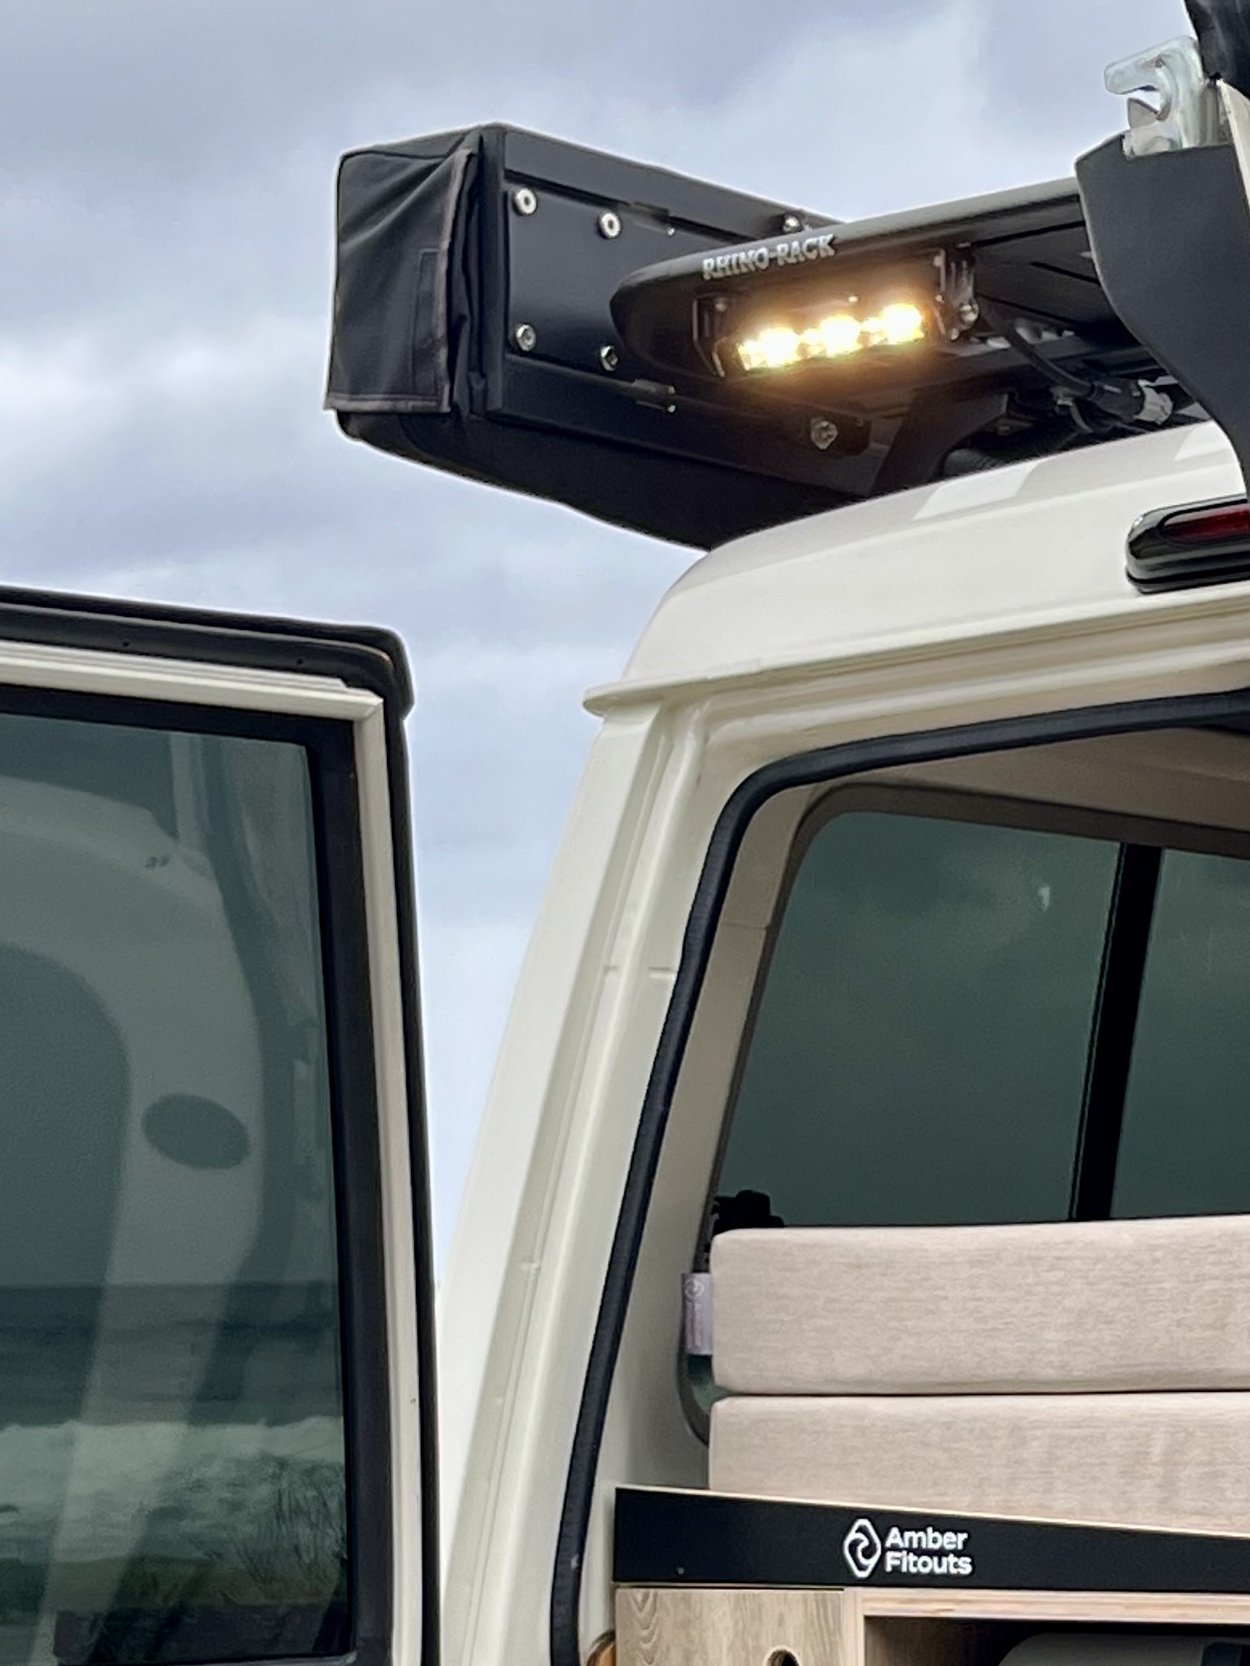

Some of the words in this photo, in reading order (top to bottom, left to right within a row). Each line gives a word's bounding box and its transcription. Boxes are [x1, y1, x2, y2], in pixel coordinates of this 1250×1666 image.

[702, 233, 836, 280] RHINO-RACK
[885, 1526, 969, 1549] Amber
[884, 1550, 973, 1575] Fitouts
